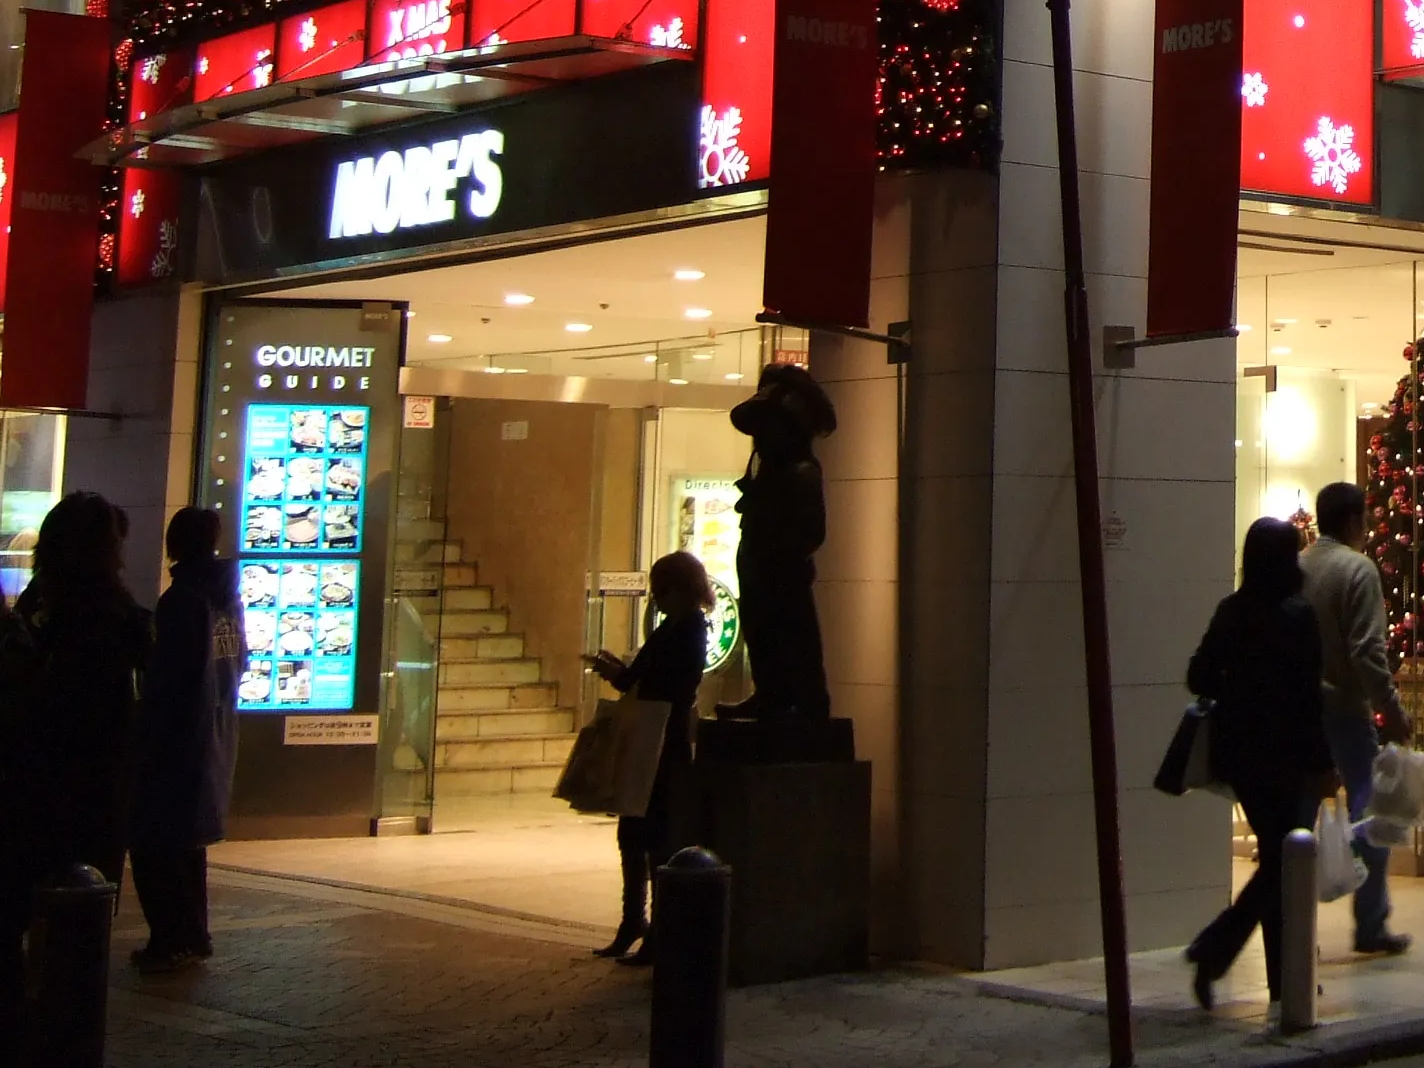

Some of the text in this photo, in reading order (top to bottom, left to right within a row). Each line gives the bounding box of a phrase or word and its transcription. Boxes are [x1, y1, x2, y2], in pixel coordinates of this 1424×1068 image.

[786, 14, 868, 50] MORE'S
[1161, 17, 1234, 54] MORE'S
[328, 129, 505, 239] MORE'S
[256, 344, 375, 368] GOURMET
[258, 373, 370, 390] GUIDE
[684, 479, 737, 491] Directo
